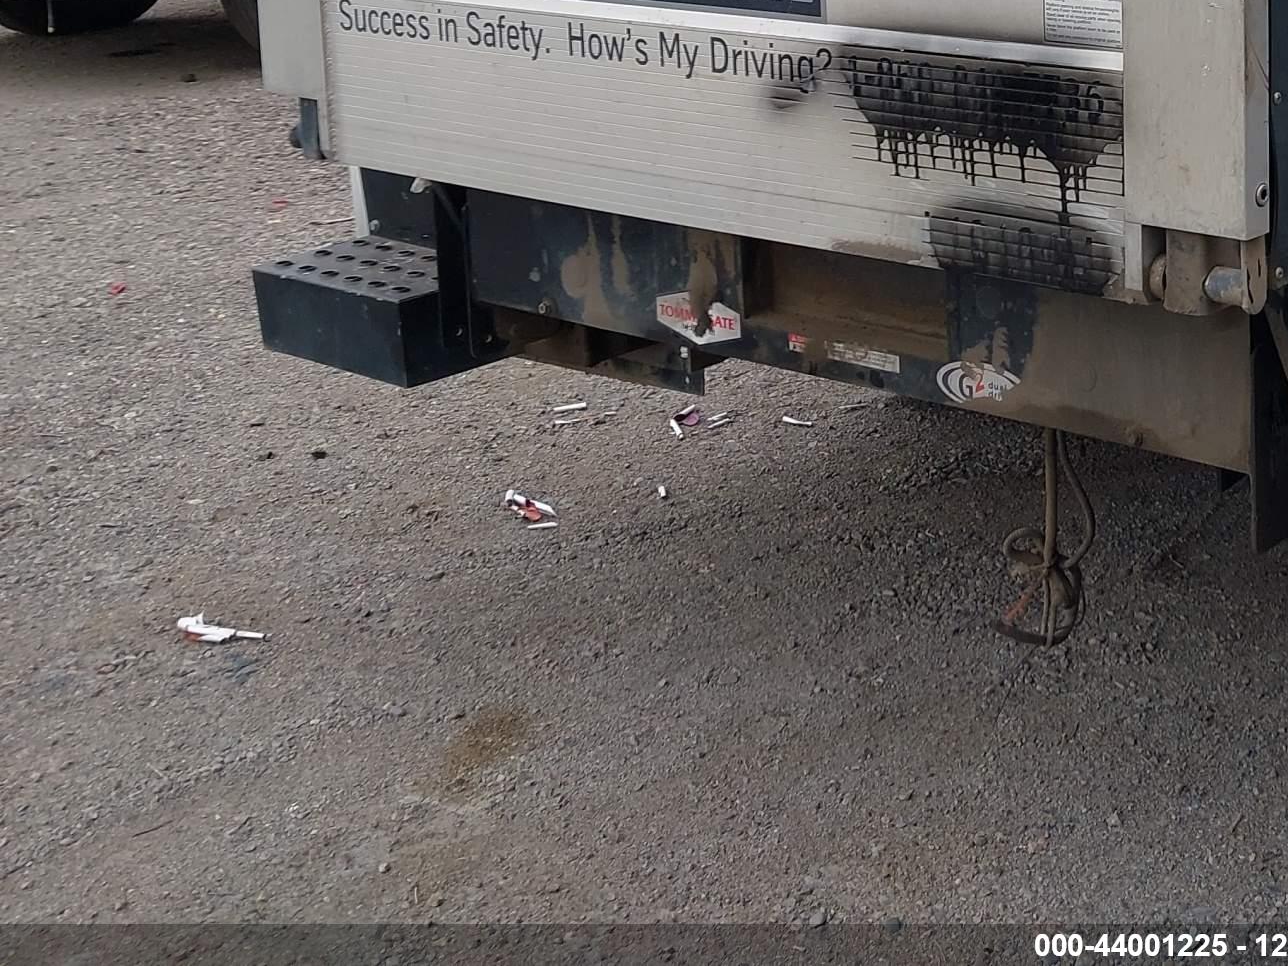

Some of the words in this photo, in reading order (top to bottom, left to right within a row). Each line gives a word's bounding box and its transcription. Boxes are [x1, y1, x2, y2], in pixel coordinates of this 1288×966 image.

[438, 9, 458, 43] in
[467, 10, 551, 61] Safety.
[567, 20, 649, 65] How's
[660, 31, 698, 79] My
[711, 37, 832, 93] Driving?
[659, 303, 697, 322] TOMM
